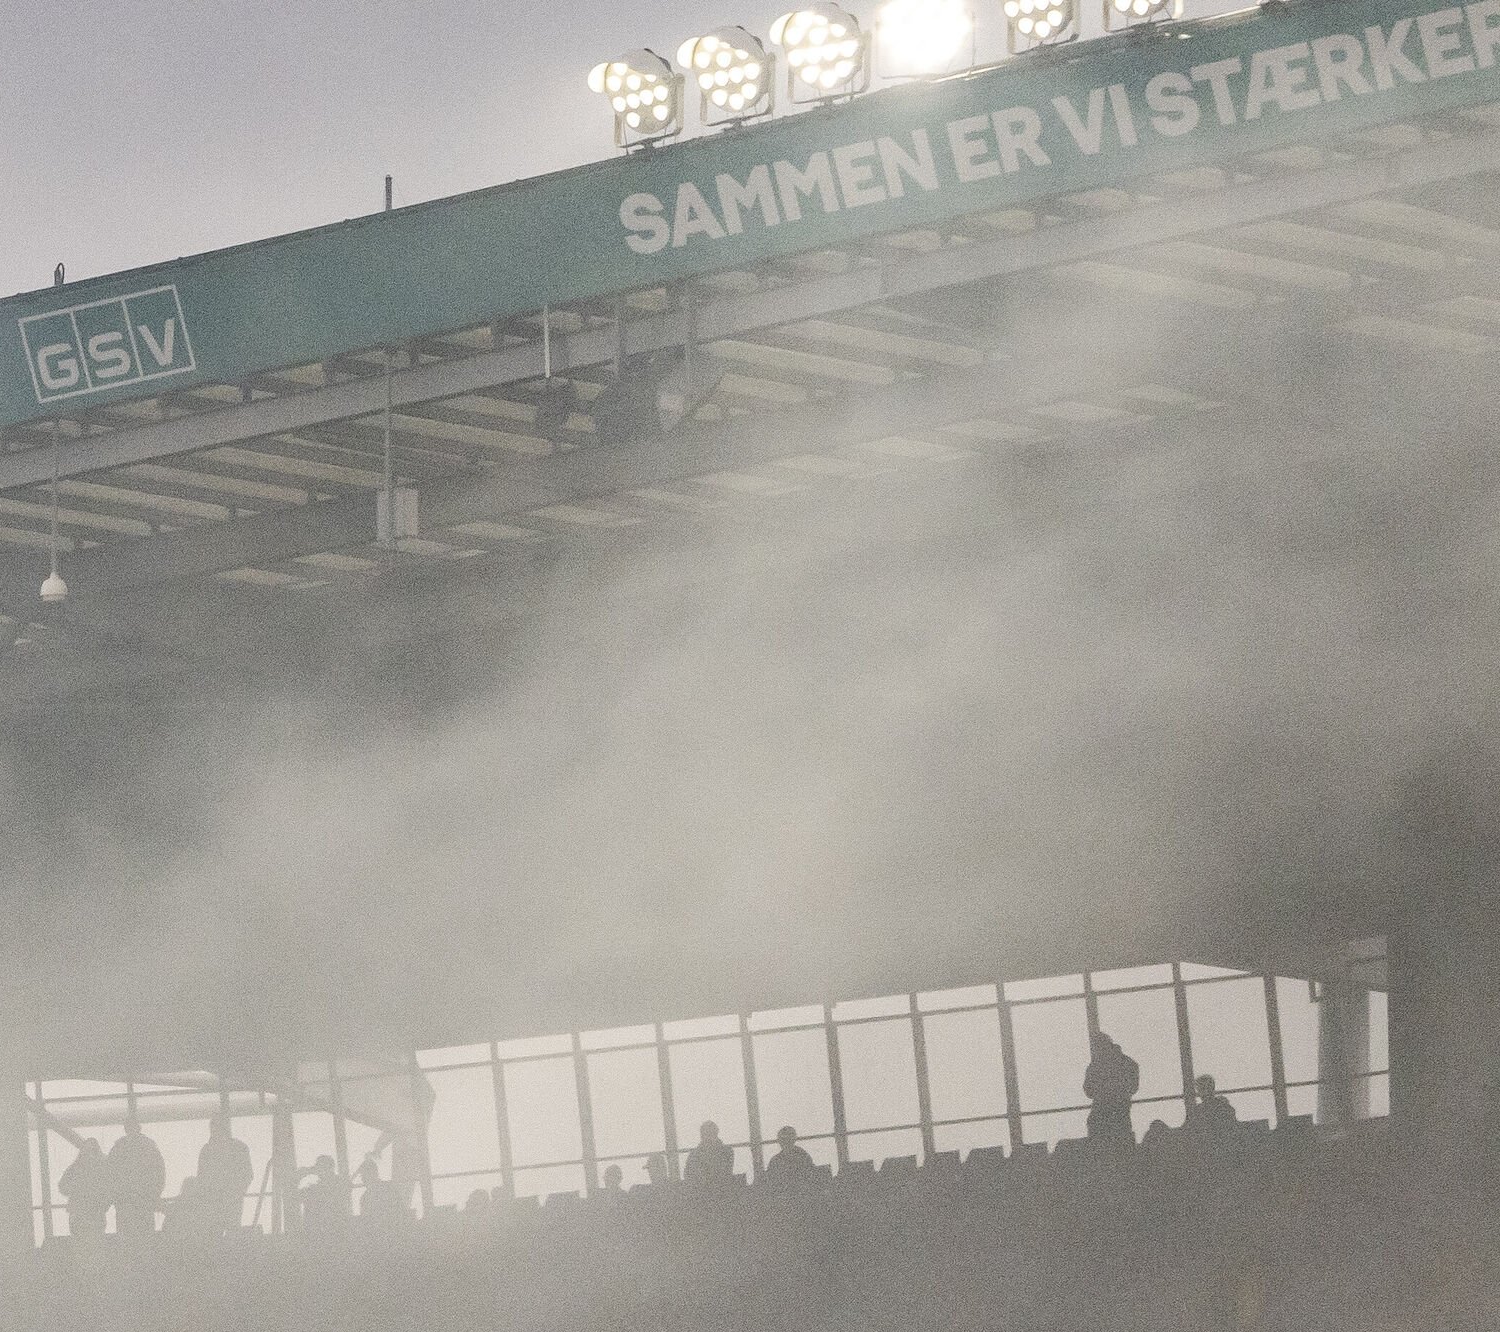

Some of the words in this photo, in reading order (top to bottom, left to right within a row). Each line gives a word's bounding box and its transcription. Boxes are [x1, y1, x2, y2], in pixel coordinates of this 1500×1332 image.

[618, 128, 937, 257] SAMMEN
[951, 106, 1052, 181] ER
[1046, 82, 1134, 157] VI
[36, 316, 177, 392] GSV
